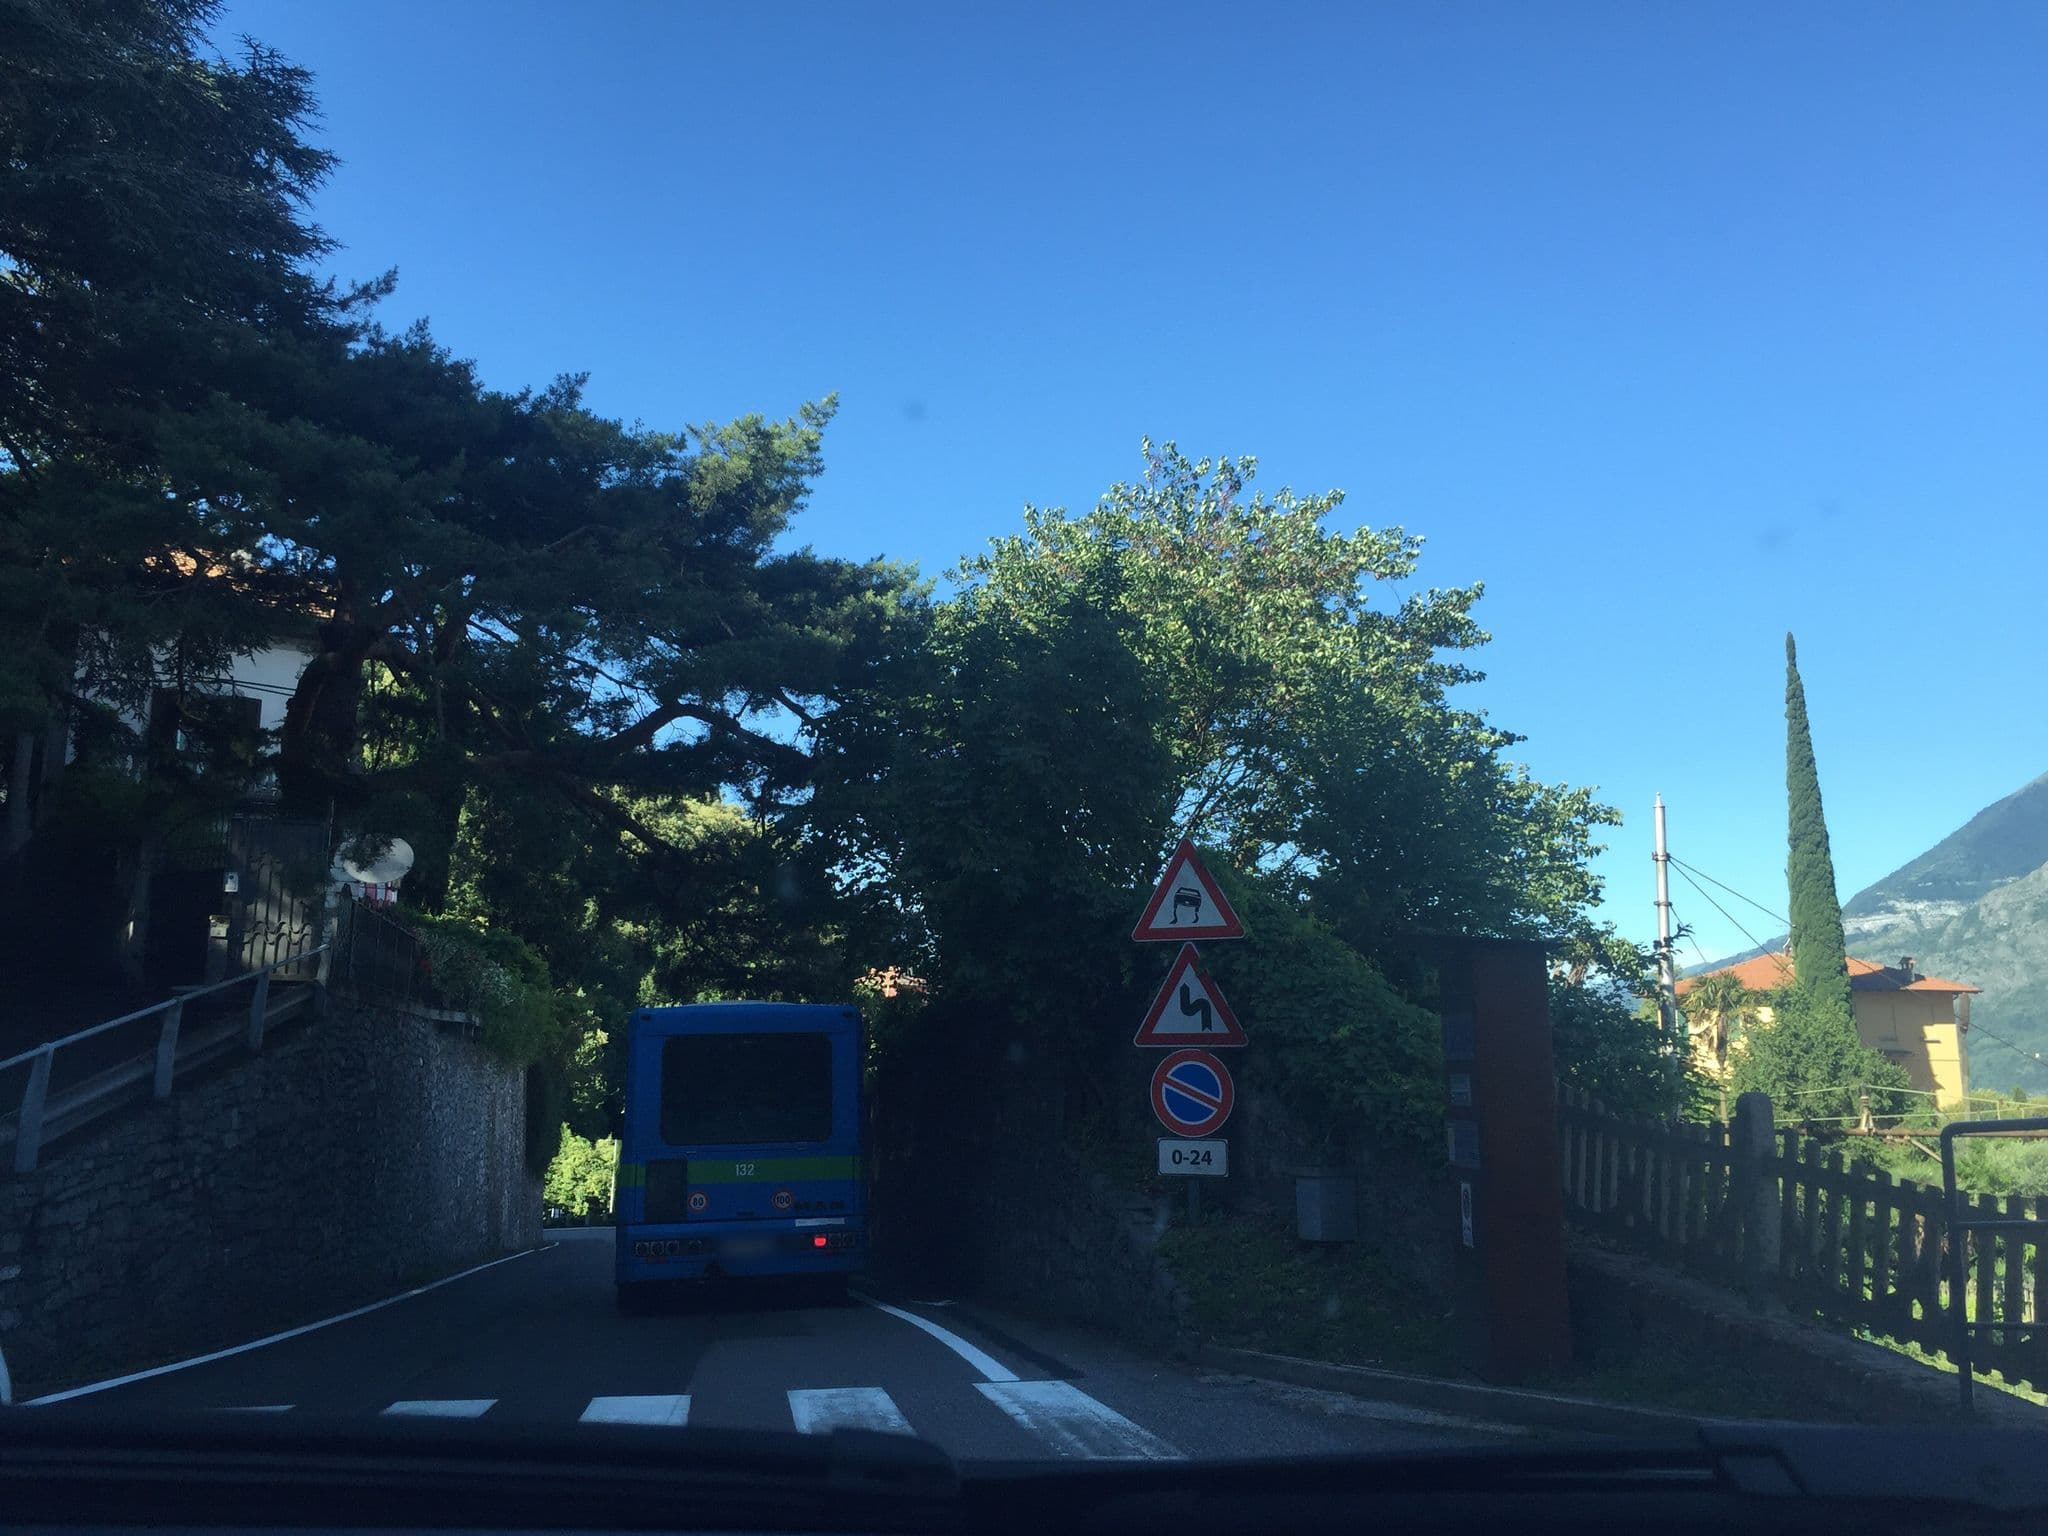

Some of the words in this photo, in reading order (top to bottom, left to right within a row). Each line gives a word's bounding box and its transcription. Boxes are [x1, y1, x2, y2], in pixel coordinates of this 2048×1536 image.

[1172, 1150, 1212, 1165] 0-24
[735, 1163, 755, 1176] 132
[692, 1196, 704, 1207] 80
[775, 1194, 791, 1206] 100
